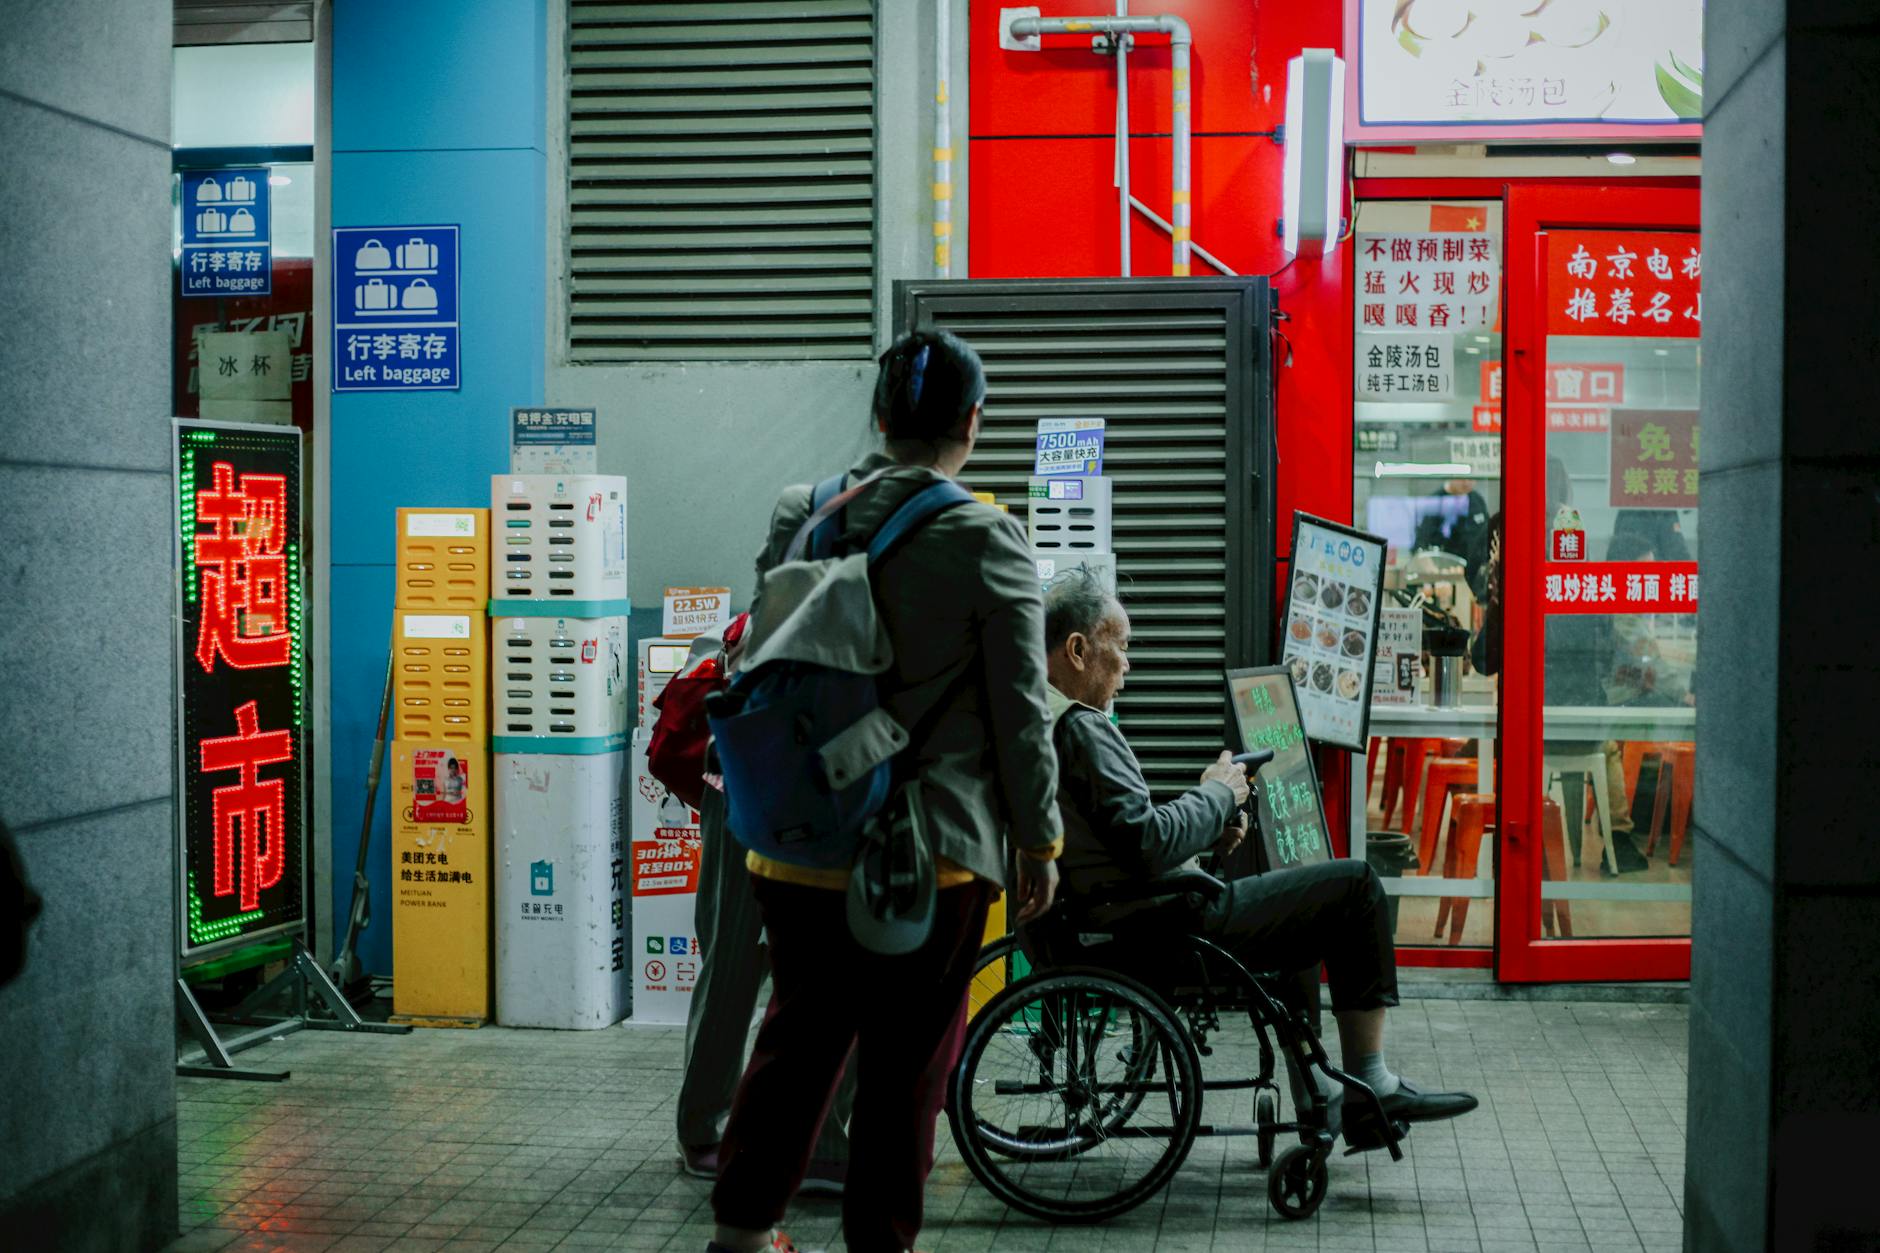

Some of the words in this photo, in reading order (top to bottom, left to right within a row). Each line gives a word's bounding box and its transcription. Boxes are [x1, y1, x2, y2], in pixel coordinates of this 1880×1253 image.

[1447, 77, 1567, 107] 金陵汤包
[1364, 237, 1490, 263] 不做预制菜
[190, 250, 262, 272] 行李寄存
[188, 277, 211, 289] Left
[216, 276, 264, 291] baggage
[1364, 271, 1490, 295] 猛火现炒
[347, 333, 447, 361] 行李寄存
[218, 355, 272, 376] 冰杯
[1367, 345, 1440, 369] 金陵汤包
[344, 366, 377, 381] Left
[382, 365, 451, 384] baggage
[1040, 447, 1098, 462] 大容量快充
[1559, 534, 1579, 552] 推
[1546, 574, 1616, 602] 现炒浇头
[1626, 574, 1660, 602] 汤面
[675, 598, 716, 612] 22.5W
[672, 612, 719, 625] 超级快充
[195, 462, 294, 912] 超市
[401, 851, 448, 865] 美团充电
[401, 869, 473, 884] 给生活加满电
[639, 861, 693, 874] 充至80%
[400, 889, 432, 897] MEITUAN
[400, 899, 426, 907] POWER
